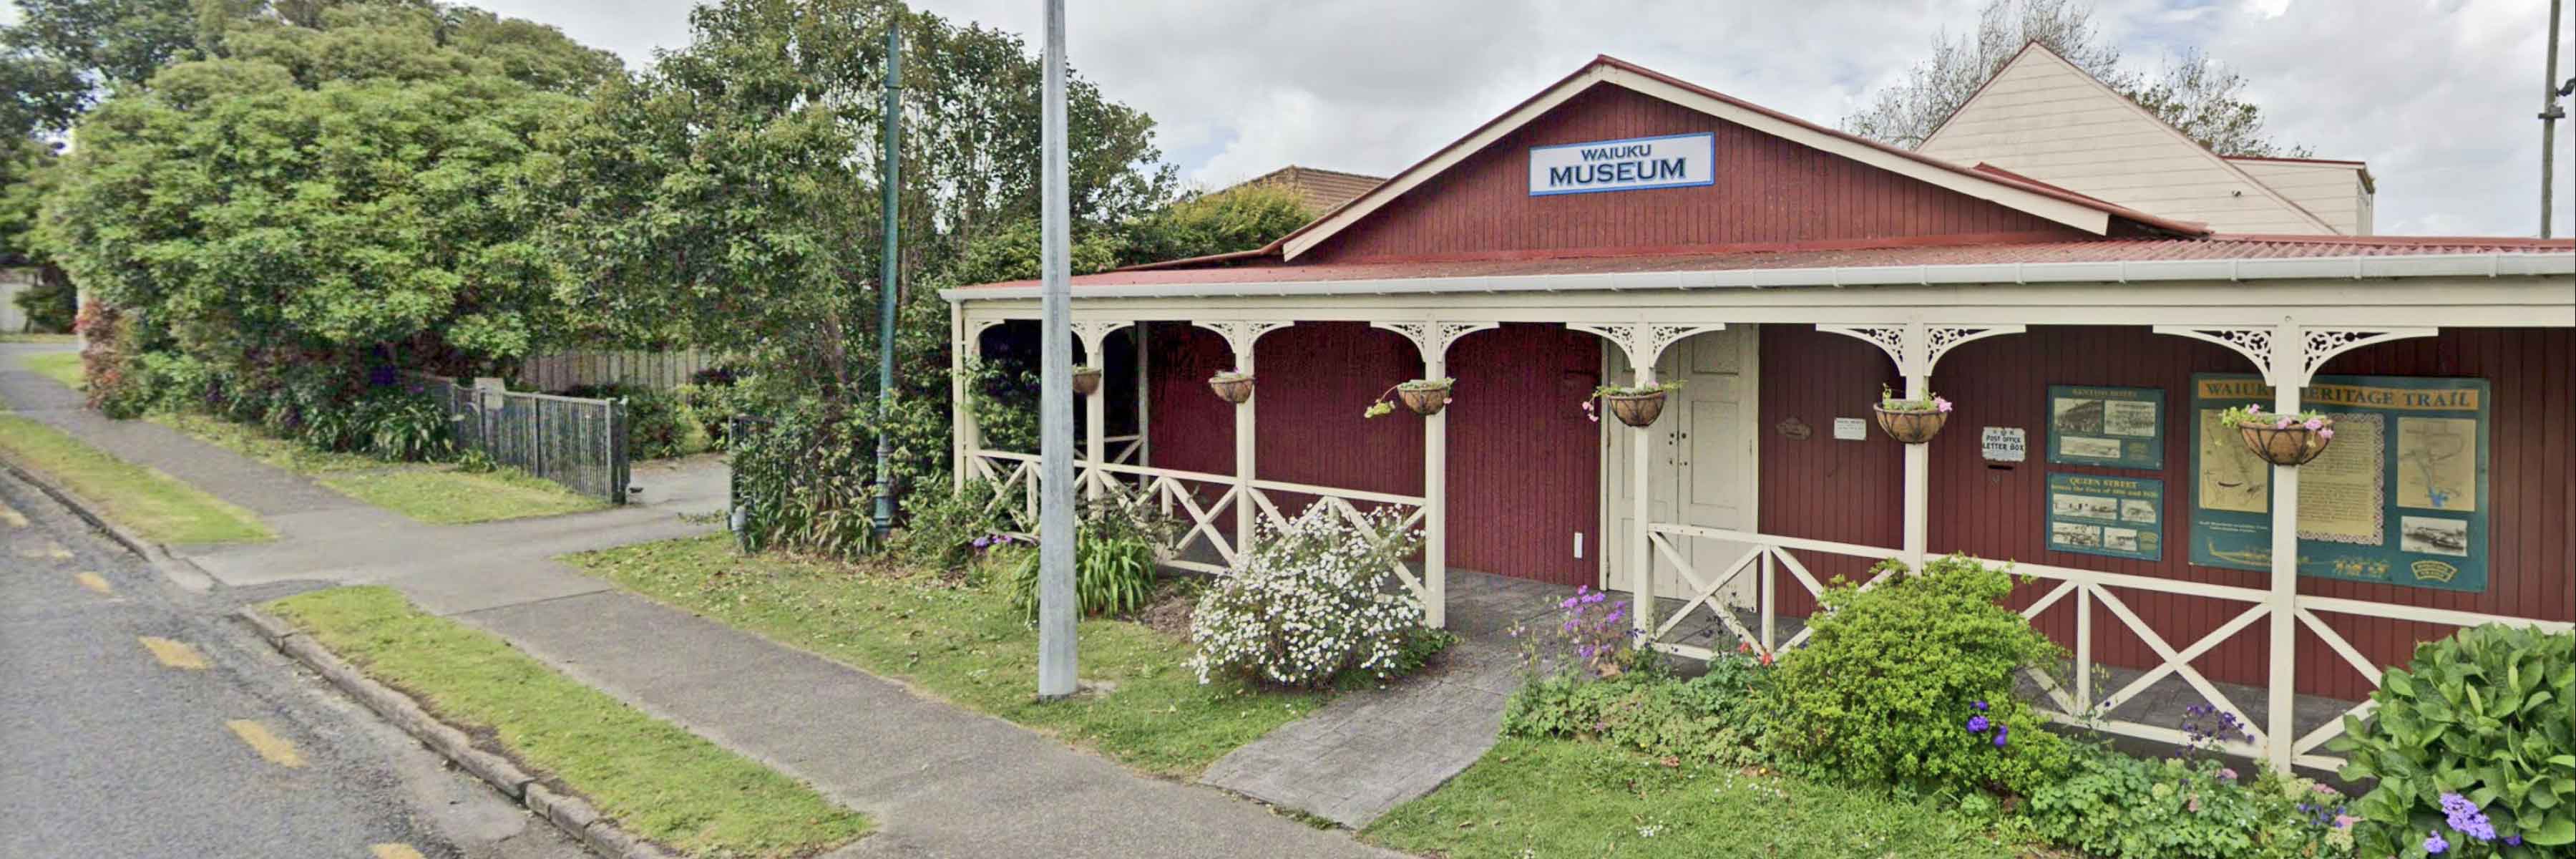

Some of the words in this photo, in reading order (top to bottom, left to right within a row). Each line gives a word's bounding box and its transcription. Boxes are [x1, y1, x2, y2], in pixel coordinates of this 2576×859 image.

[1581, 144, 1652, 162] WAIUKU
[1549, 157, 1687, 187] MUSEUM
[2205, 382, 2276, 397] WAIUK
[2404, 390, 2472, 407] TRAIL
